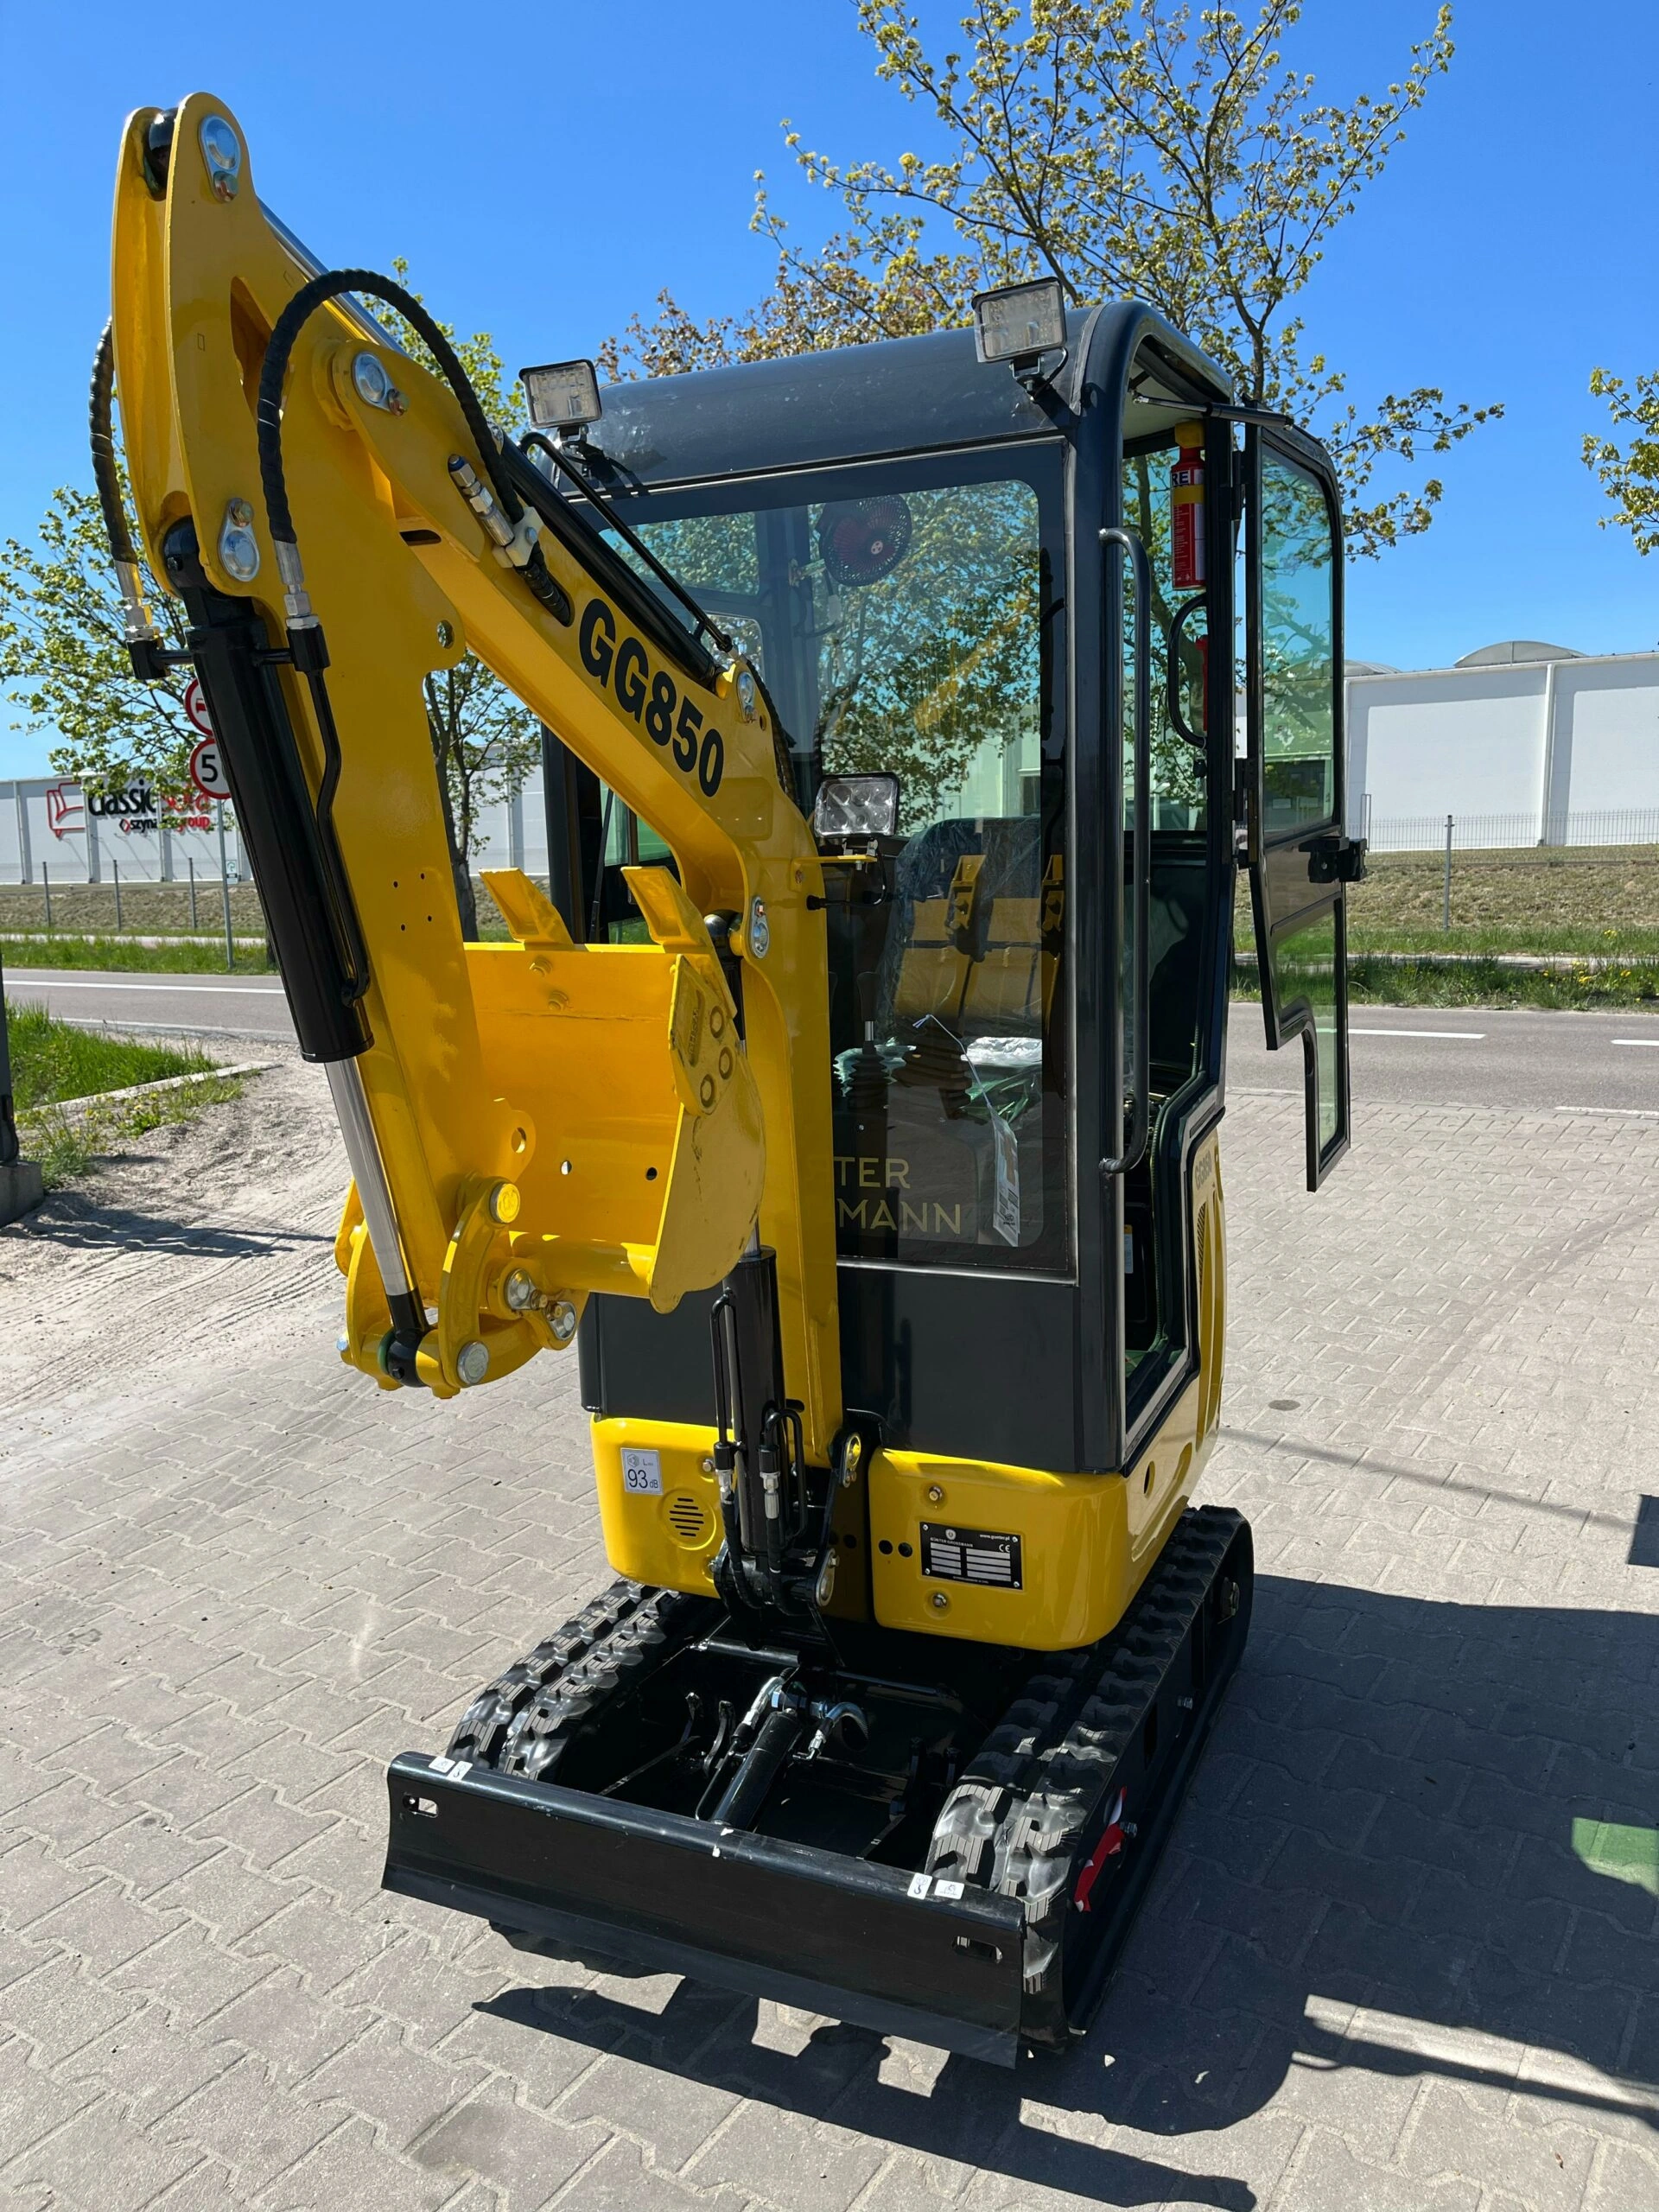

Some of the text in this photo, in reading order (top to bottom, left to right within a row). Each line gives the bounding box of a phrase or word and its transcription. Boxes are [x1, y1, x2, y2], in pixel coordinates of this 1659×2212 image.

[579, 598, 724, 798] GG850
[833, 1156, 911, 1189] TER
[836, 1198, 961, 1235] MANN
[627, 1468, 658, 1489] 93 dB
